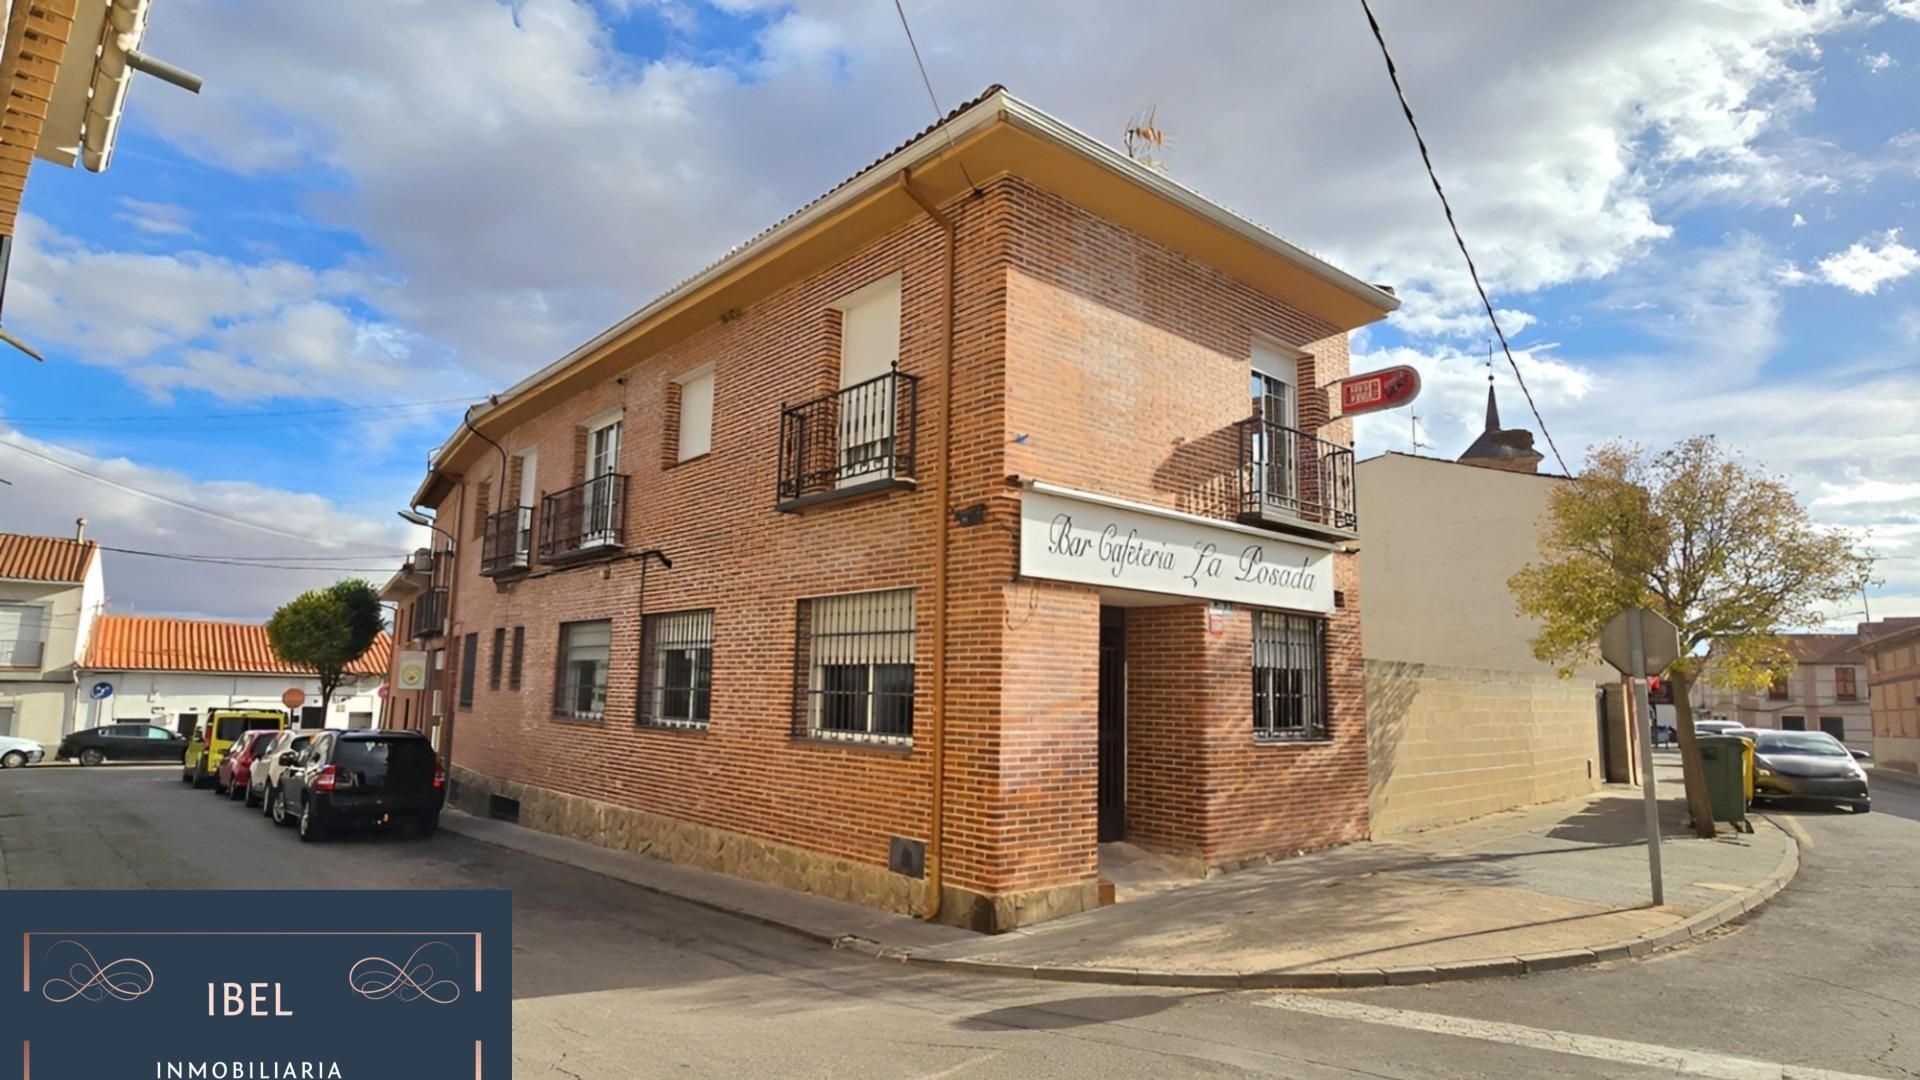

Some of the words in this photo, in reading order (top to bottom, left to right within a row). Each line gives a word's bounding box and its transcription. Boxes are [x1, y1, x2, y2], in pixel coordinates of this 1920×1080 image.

[1048, 513, 1092, 557] Bar
[1098, 522, 1175, 578] Cafeteria
[1183, 541, 1223, 588] La
[1234, 544, 1315, 591] Posada
